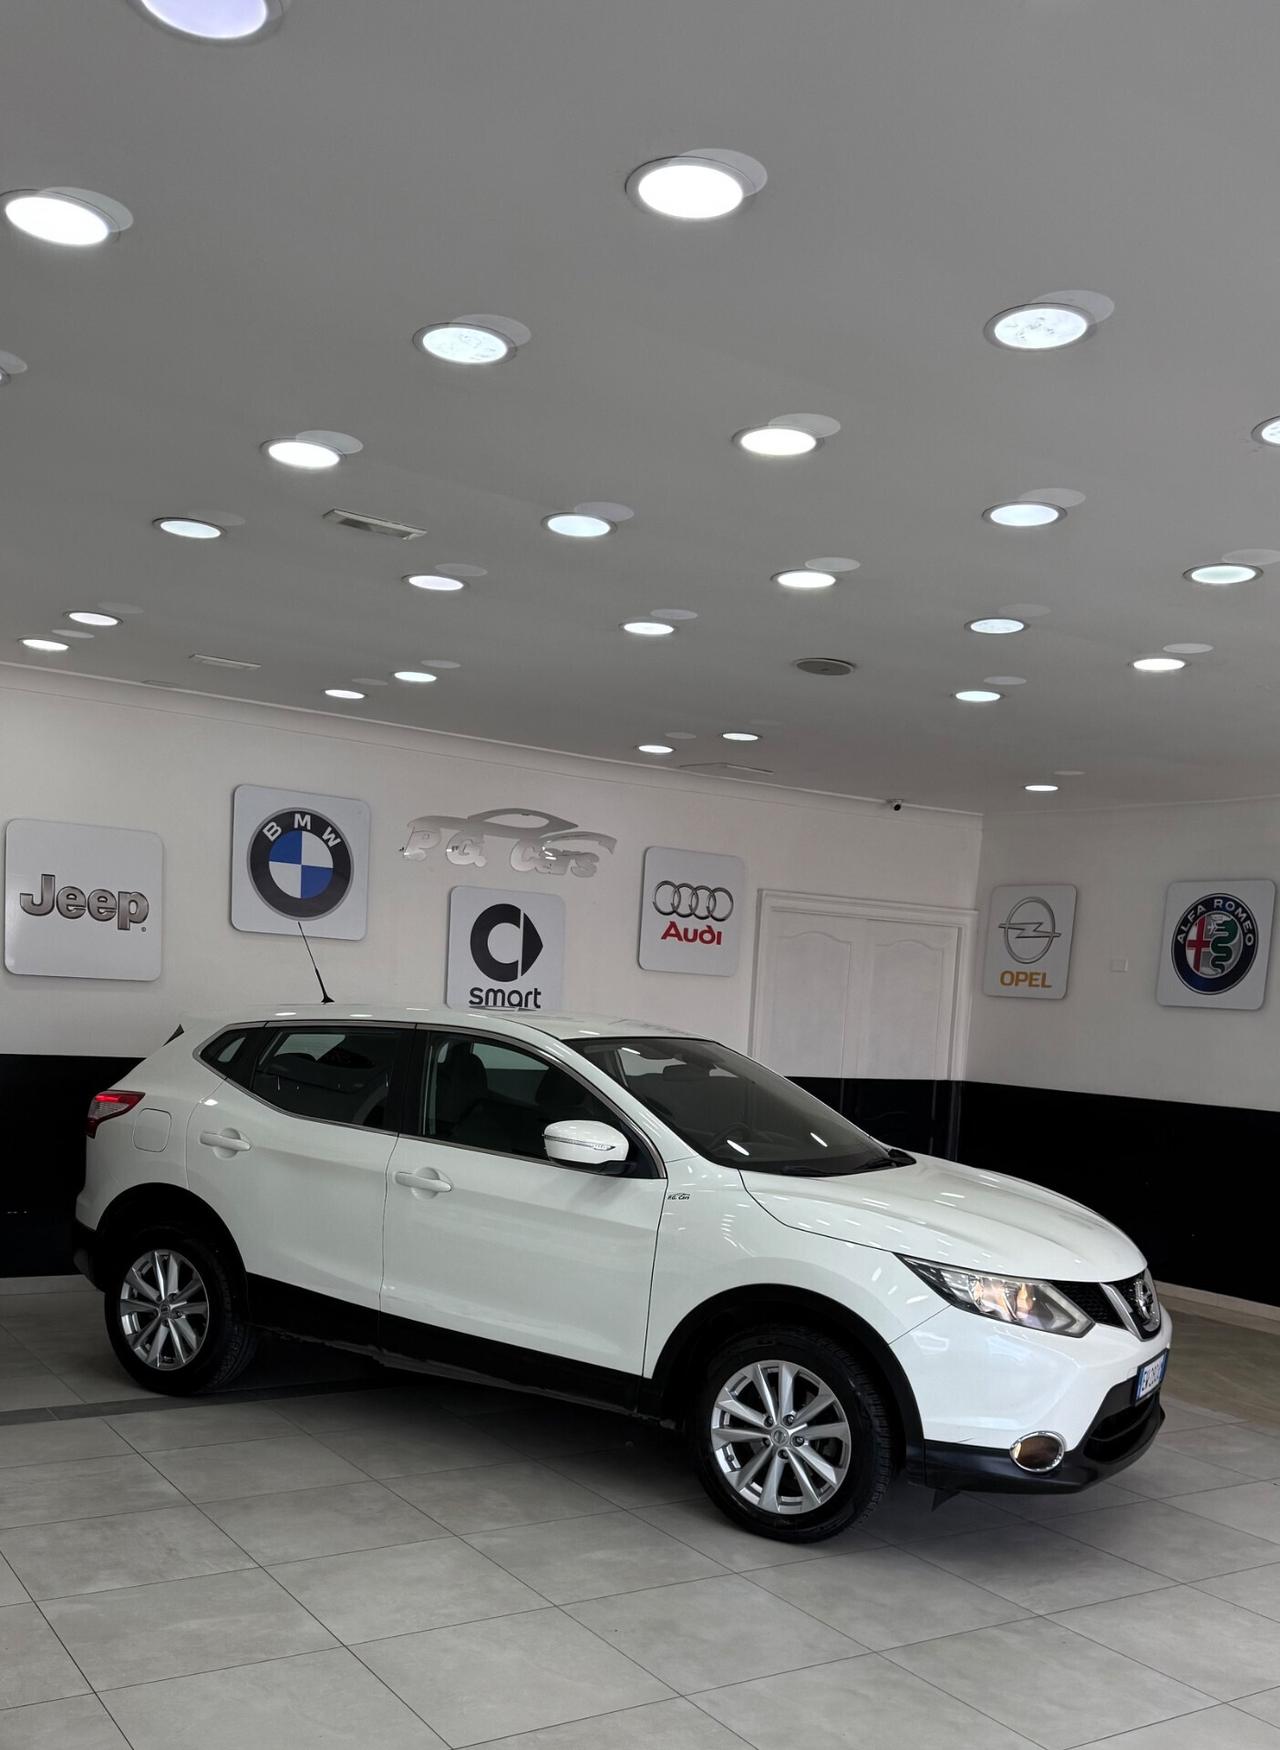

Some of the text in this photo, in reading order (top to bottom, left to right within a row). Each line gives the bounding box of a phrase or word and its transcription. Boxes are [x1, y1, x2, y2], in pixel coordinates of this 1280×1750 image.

[262, 813, 341, 848] BMW
[19, 873, 150, 931] Jeep
[661, 920, 723, 946] Audi
[1177, 899, 1254, 946] ALFA ROMEO
[1000, 970, 1052, 988] OPEL
[468, 986, 542, 1009] smart
